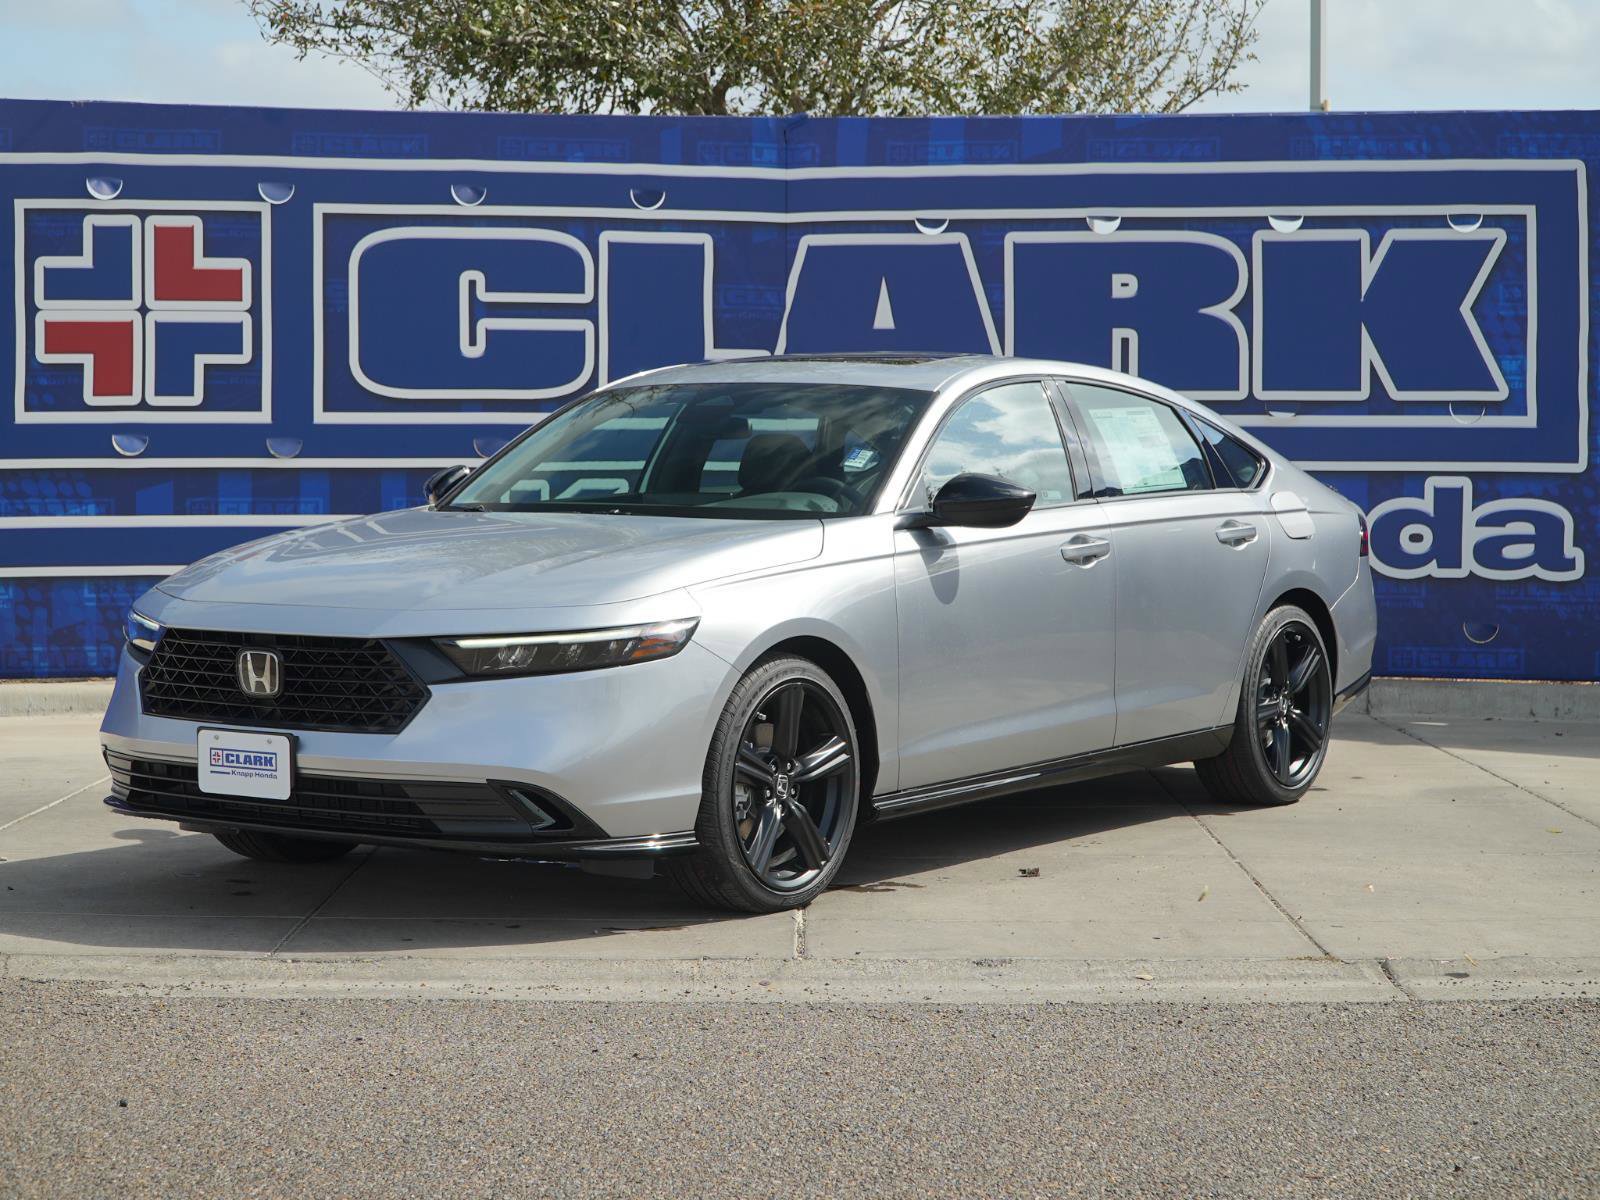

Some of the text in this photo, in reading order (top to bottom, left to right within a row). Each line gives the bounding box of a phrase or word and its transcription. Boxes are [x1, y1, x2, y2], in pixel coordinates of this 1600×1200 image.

[348, 226, 1508, 401] CLARK
[1367, 476, 1585, 582] da
[225, 753, 274, 767] CLARK
[231, 770, 278, 780] Knapp Honda
